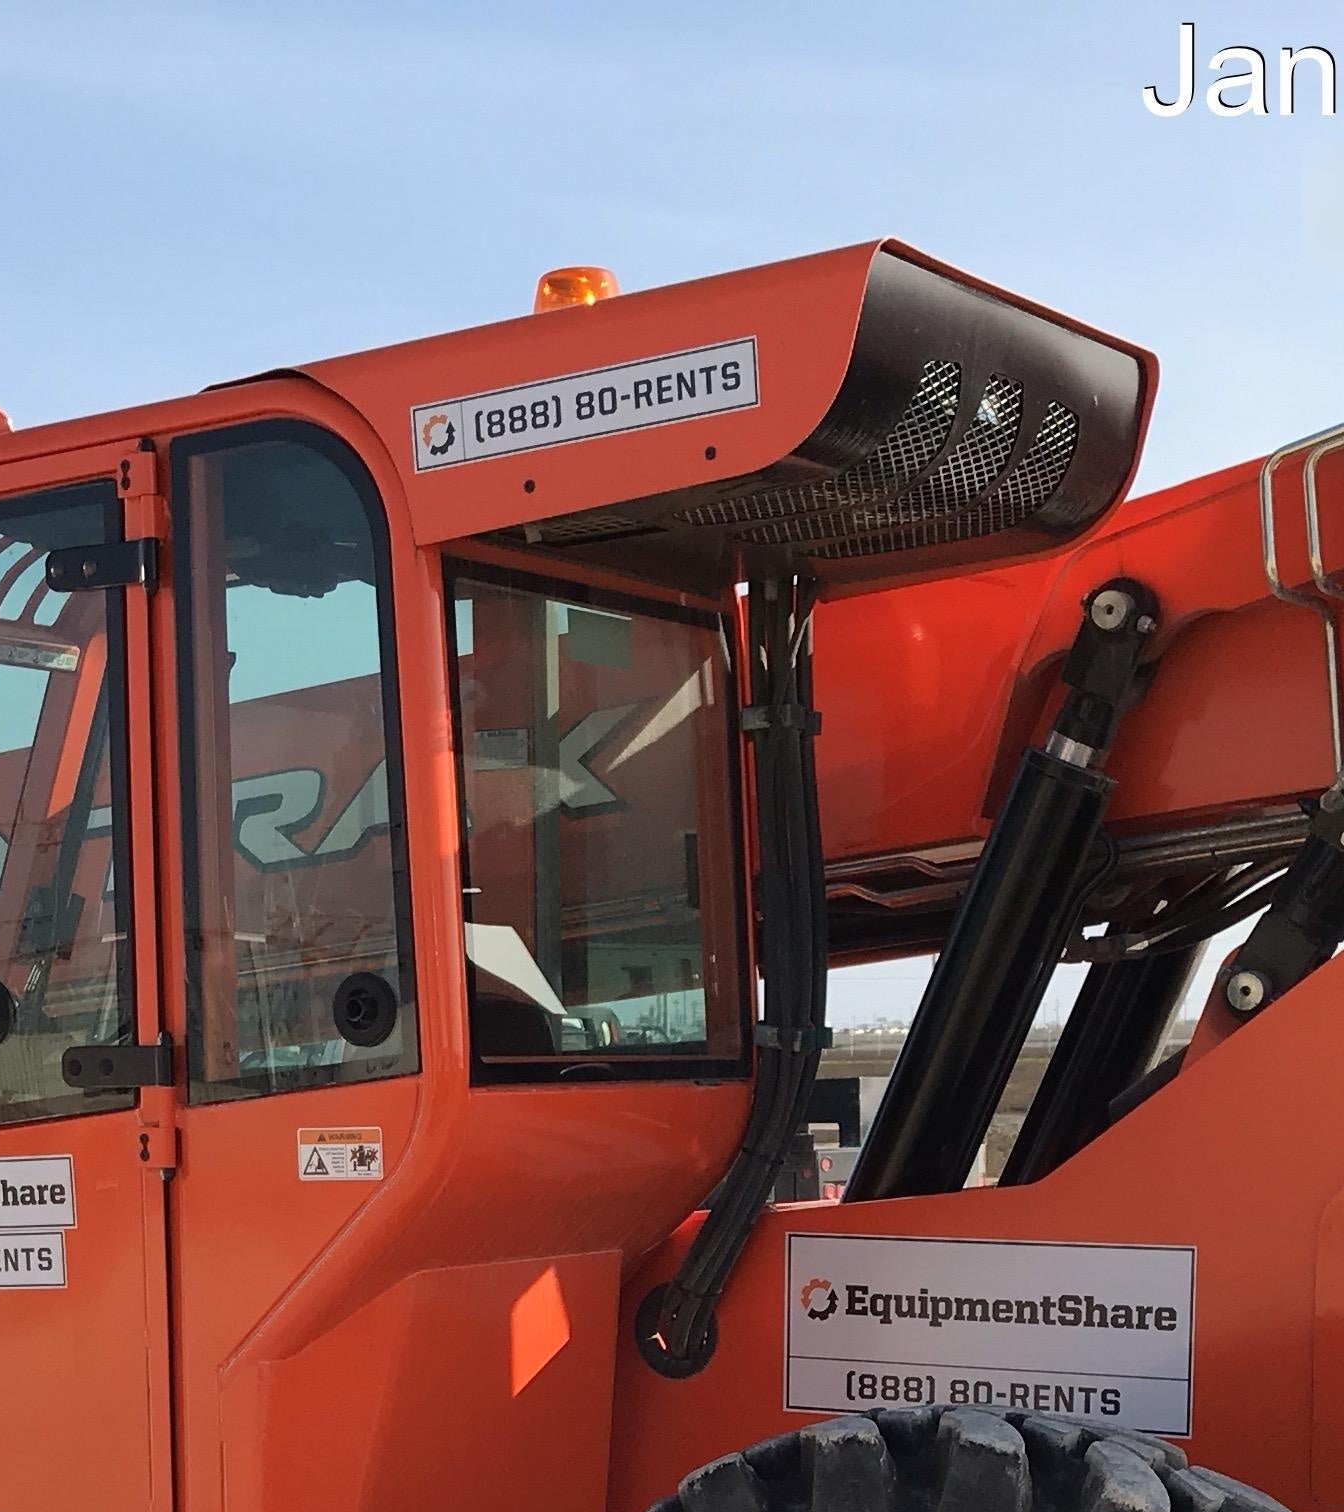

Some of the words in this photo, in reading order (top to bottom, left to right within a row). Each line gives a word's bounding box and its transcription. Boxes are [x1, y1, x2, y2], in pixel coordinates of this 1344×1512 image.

[474, 395, 562, 443] (888)
[575, 360, 741, 421] 80-RENTS
[844, 1284, 1178, 1332] EquipmentShare
[845, 1370, 936, 1405] (888)
[950, 1379, 1122, 1416] 80-RENTS
